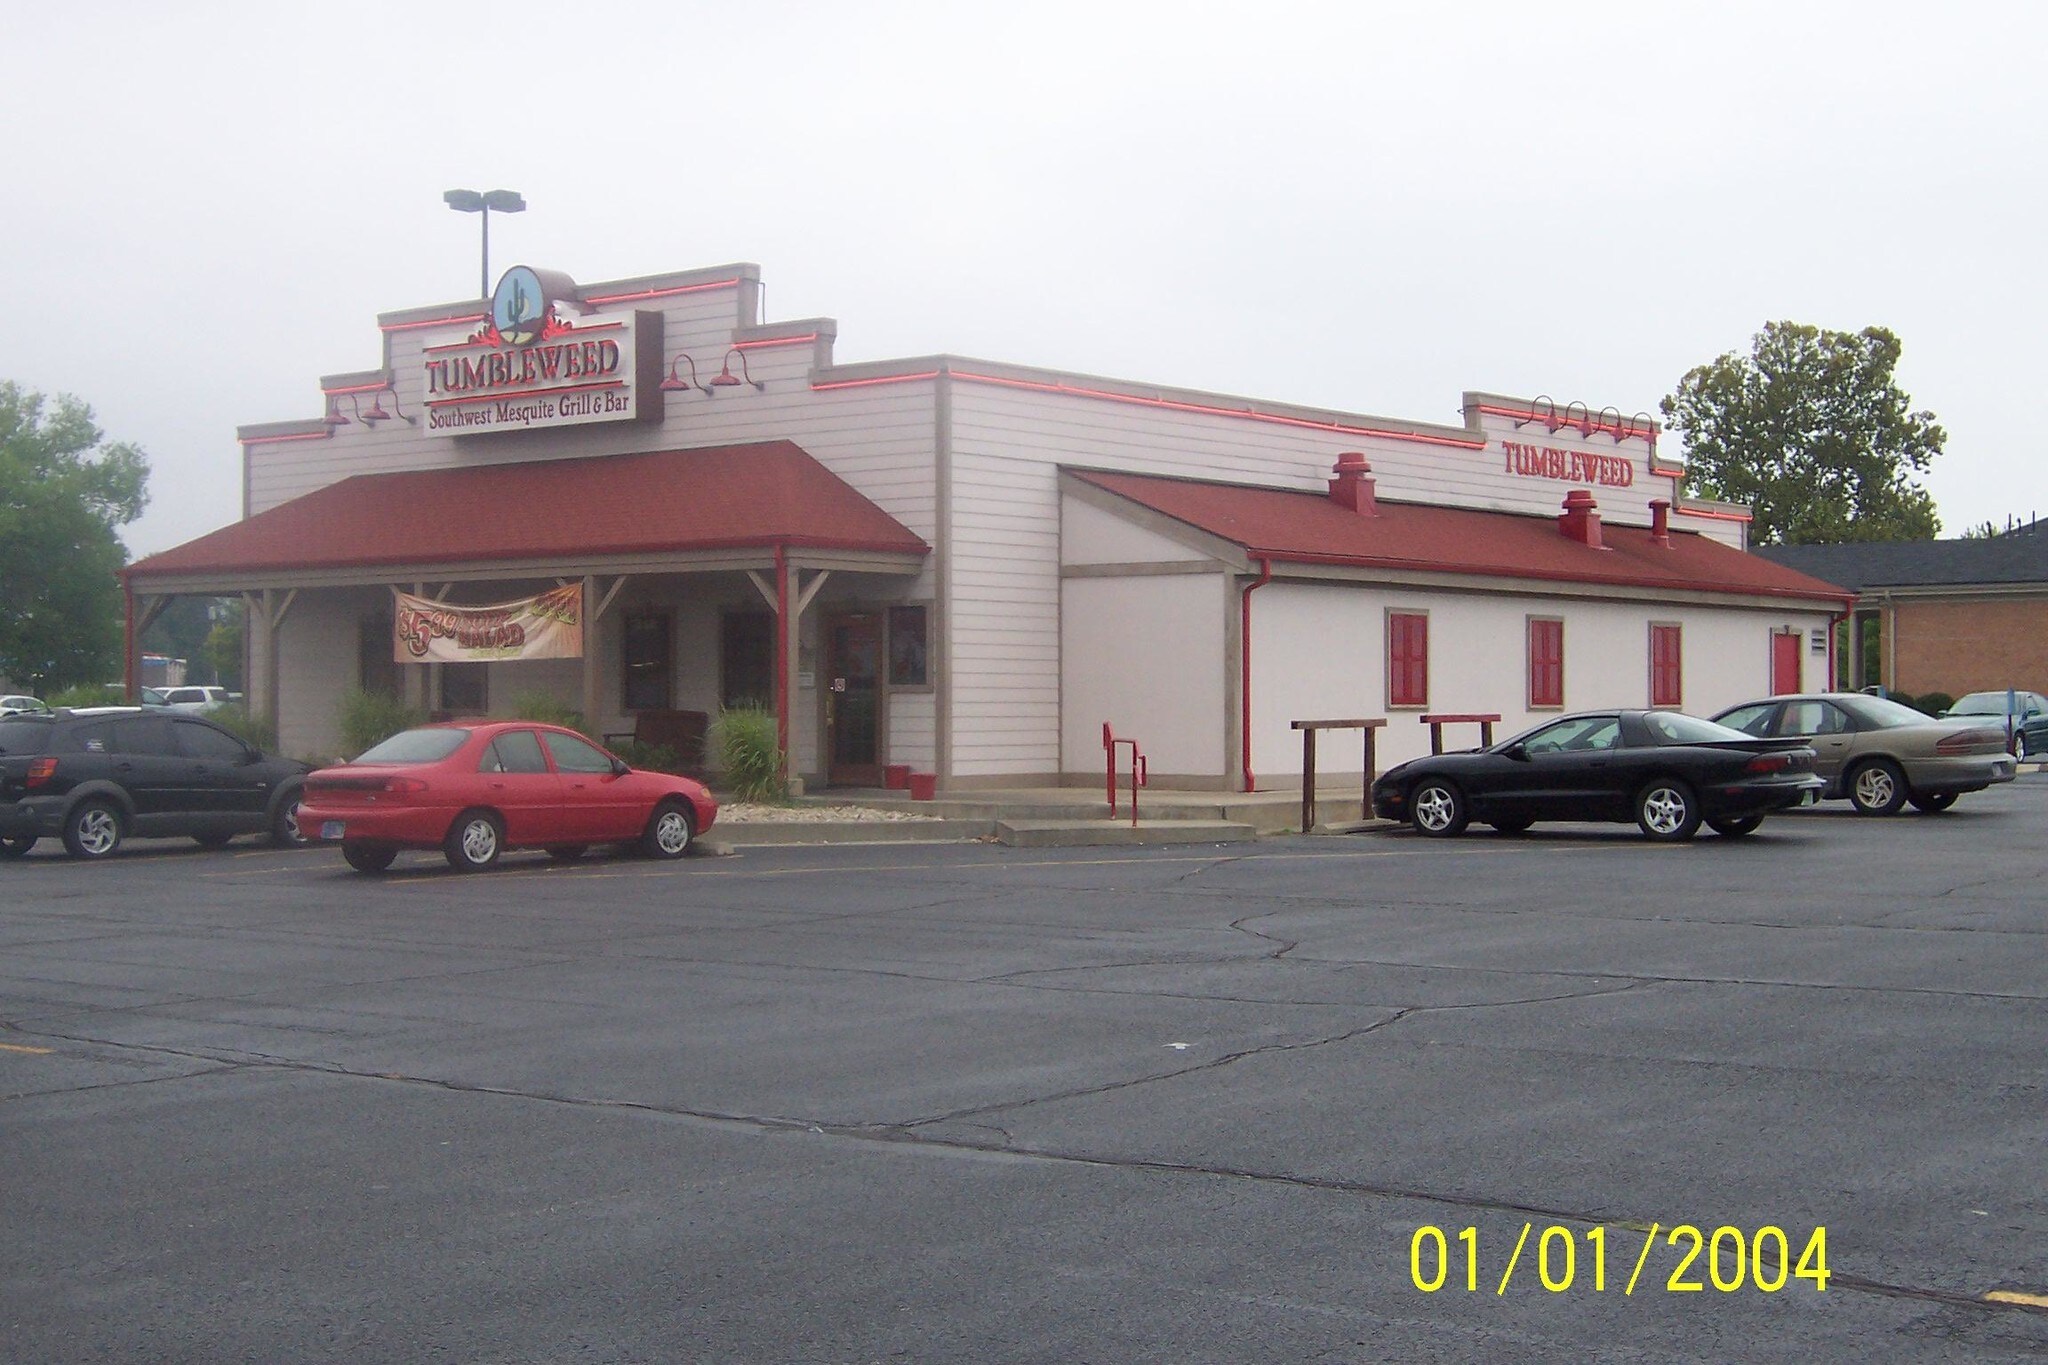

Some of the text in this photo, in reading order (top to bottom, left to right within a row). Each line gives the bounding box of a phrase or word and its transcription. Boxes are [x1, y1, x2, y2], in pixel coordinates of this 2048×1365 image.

[425, 339, 620, 394] TUMBLEWEED
[429, 391, 629, 430] Southwest Mesquite Grill & Bar
[1502, 440, 1634, 487] TUMBLEWEED
